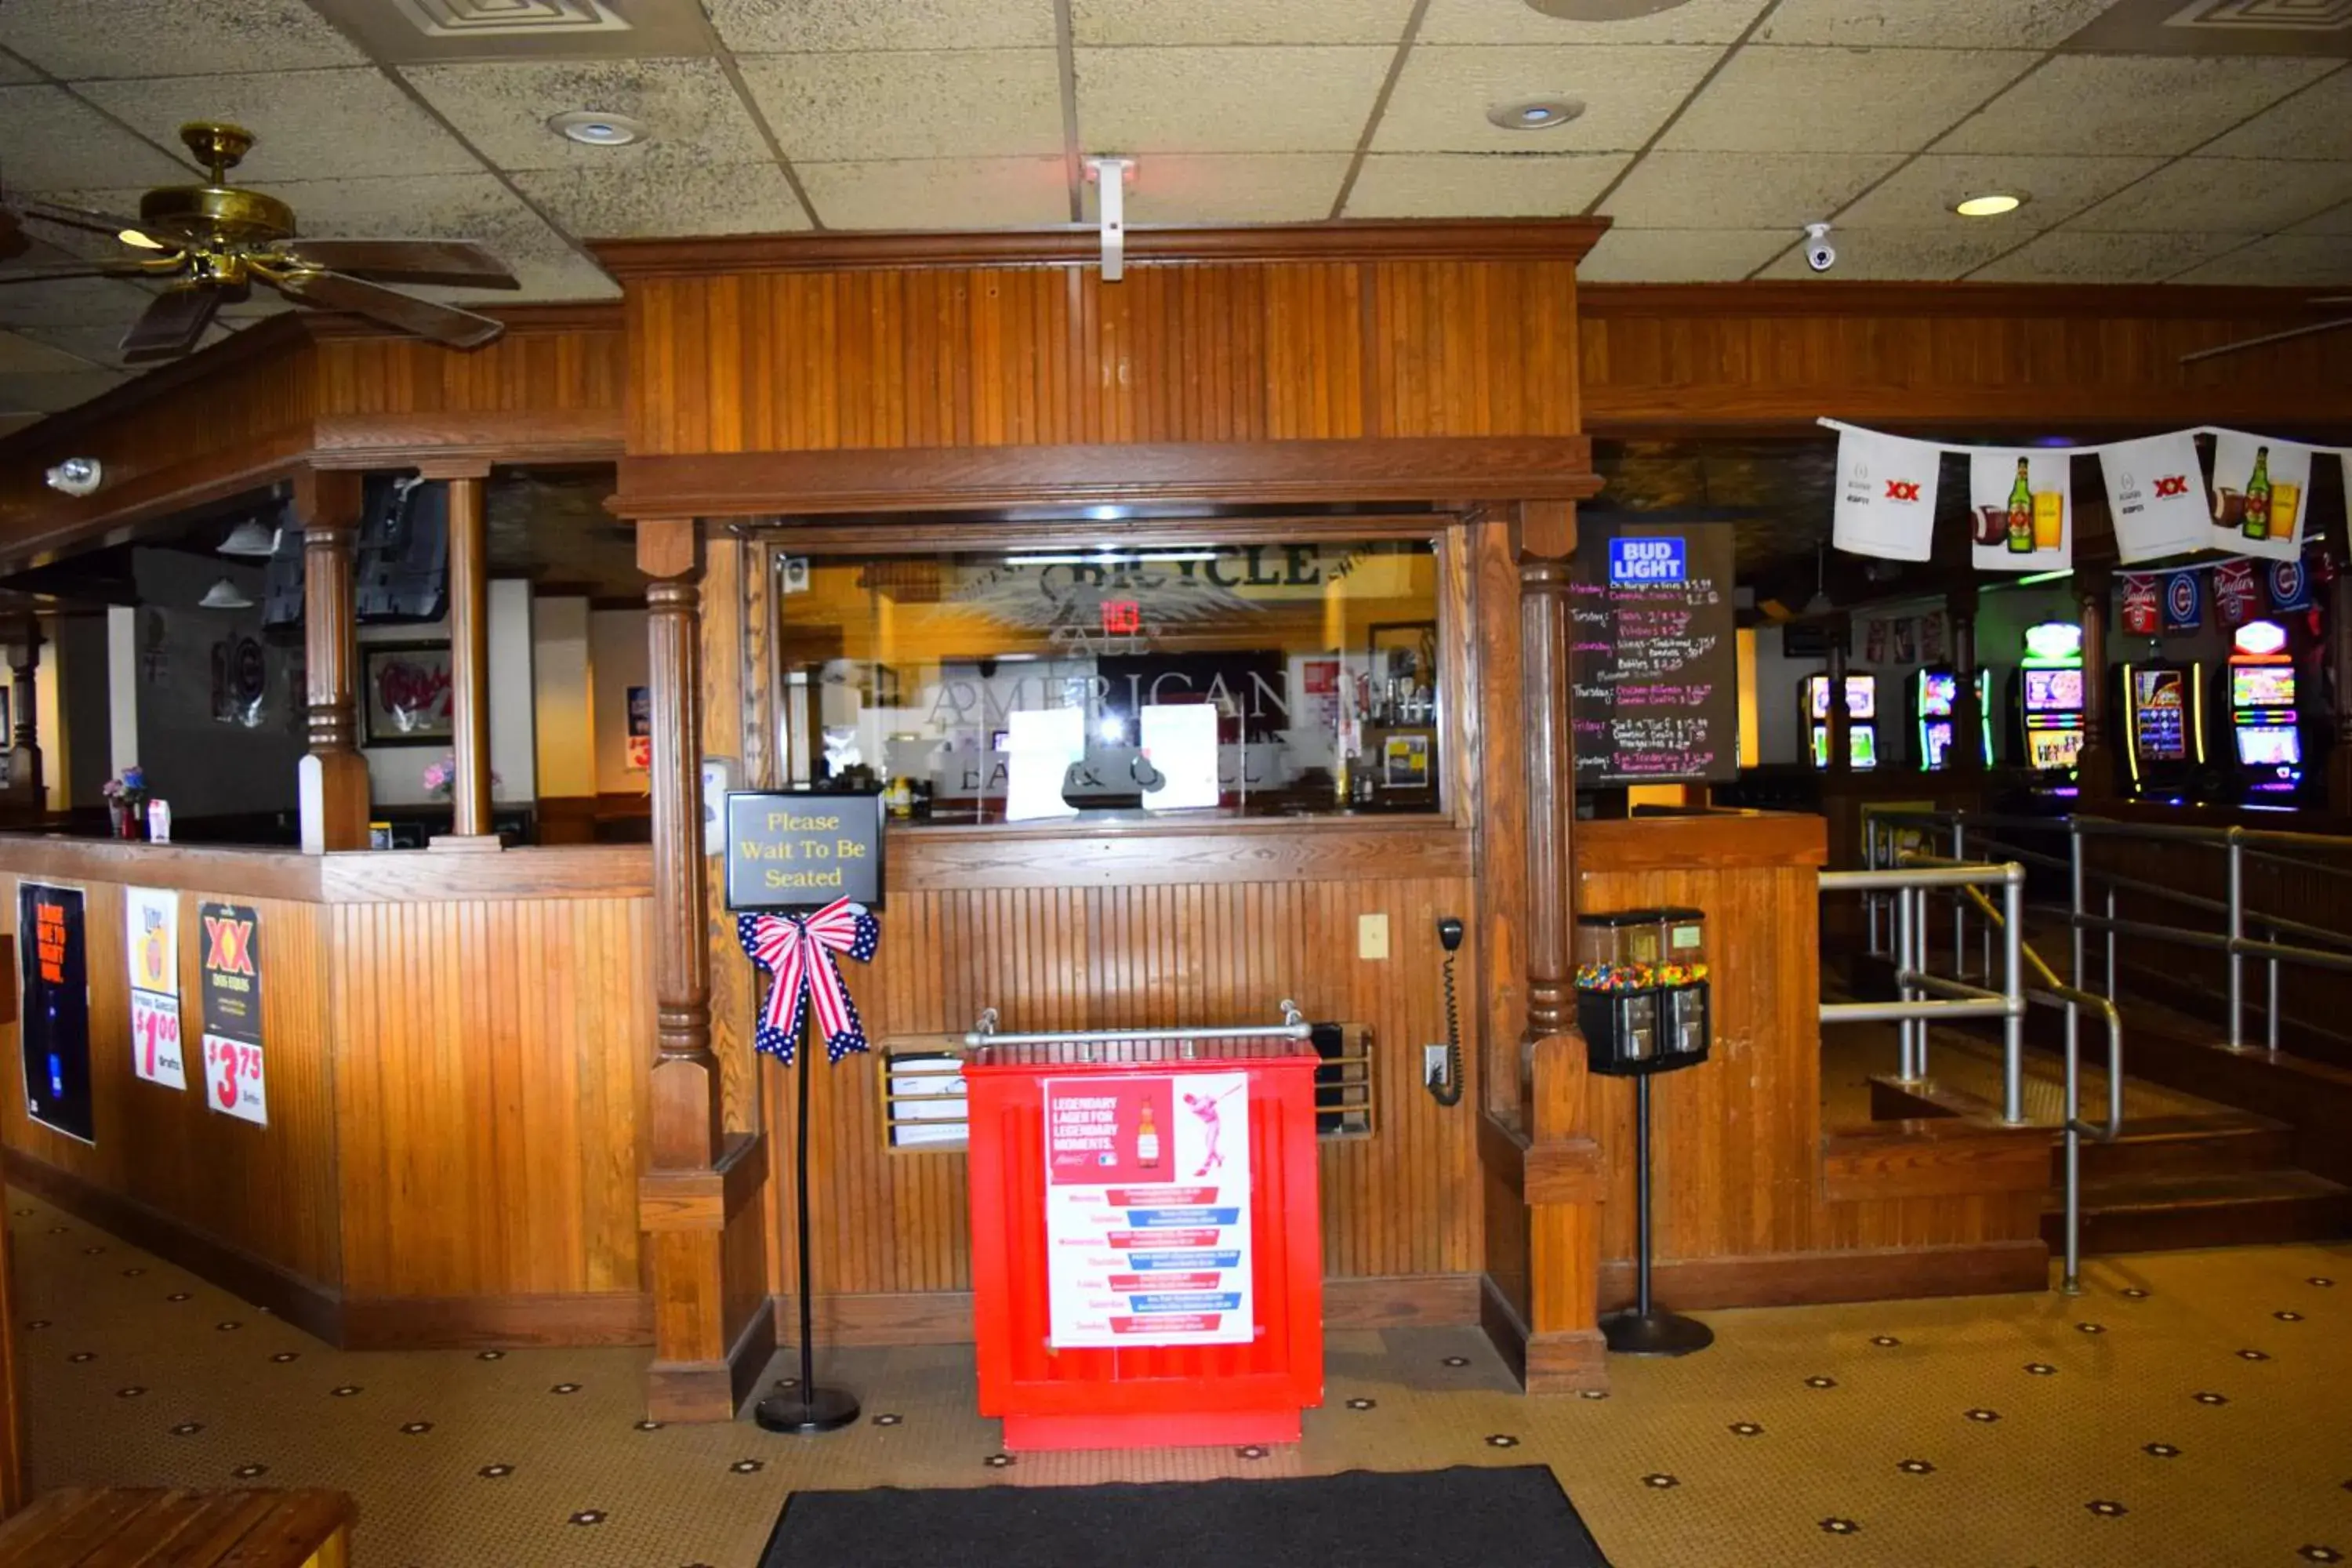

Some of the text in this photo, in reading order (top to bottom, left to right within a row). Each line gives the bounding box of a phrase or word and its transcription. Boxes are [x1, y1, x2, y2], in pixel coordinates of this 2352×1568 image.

[1622, 541, 1672, 561] BUD
[1613, 560, 1681, 578] LIGHT
[1067, 626, 1152, 657] ALL
[926, 670, 1294, 728] AMERICAN
[767, 812, 840, 832] Please
[740, 839, 866, 860] Wait To Be
[765, 867, 842, 888] Seated
[204, 916, 256, 977] XX
